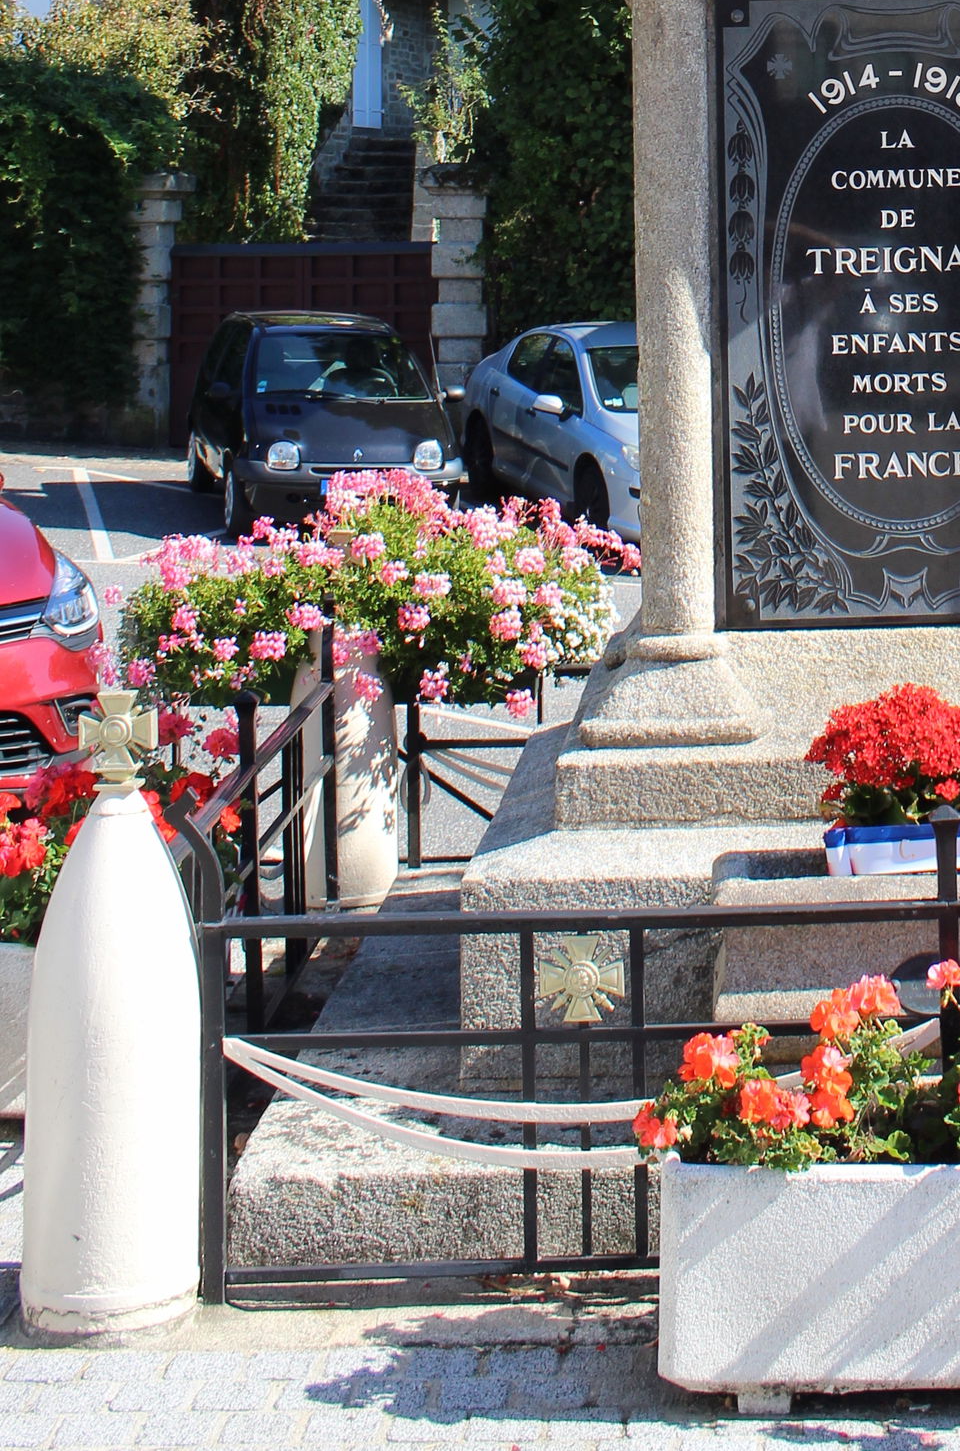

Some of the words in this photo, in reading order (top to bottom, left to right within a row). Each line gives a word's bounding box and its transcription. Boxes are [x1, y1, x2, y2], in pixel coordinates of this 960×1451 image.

[808, 64, 880, 114] 1914
[880, 129, 915, 148] LA
[880, 209, 916, 228] DE
[889, 293, 939, 313] SES
[852, 372, 947, 394] MORTS
[843, 412, 916, 434] POUR
